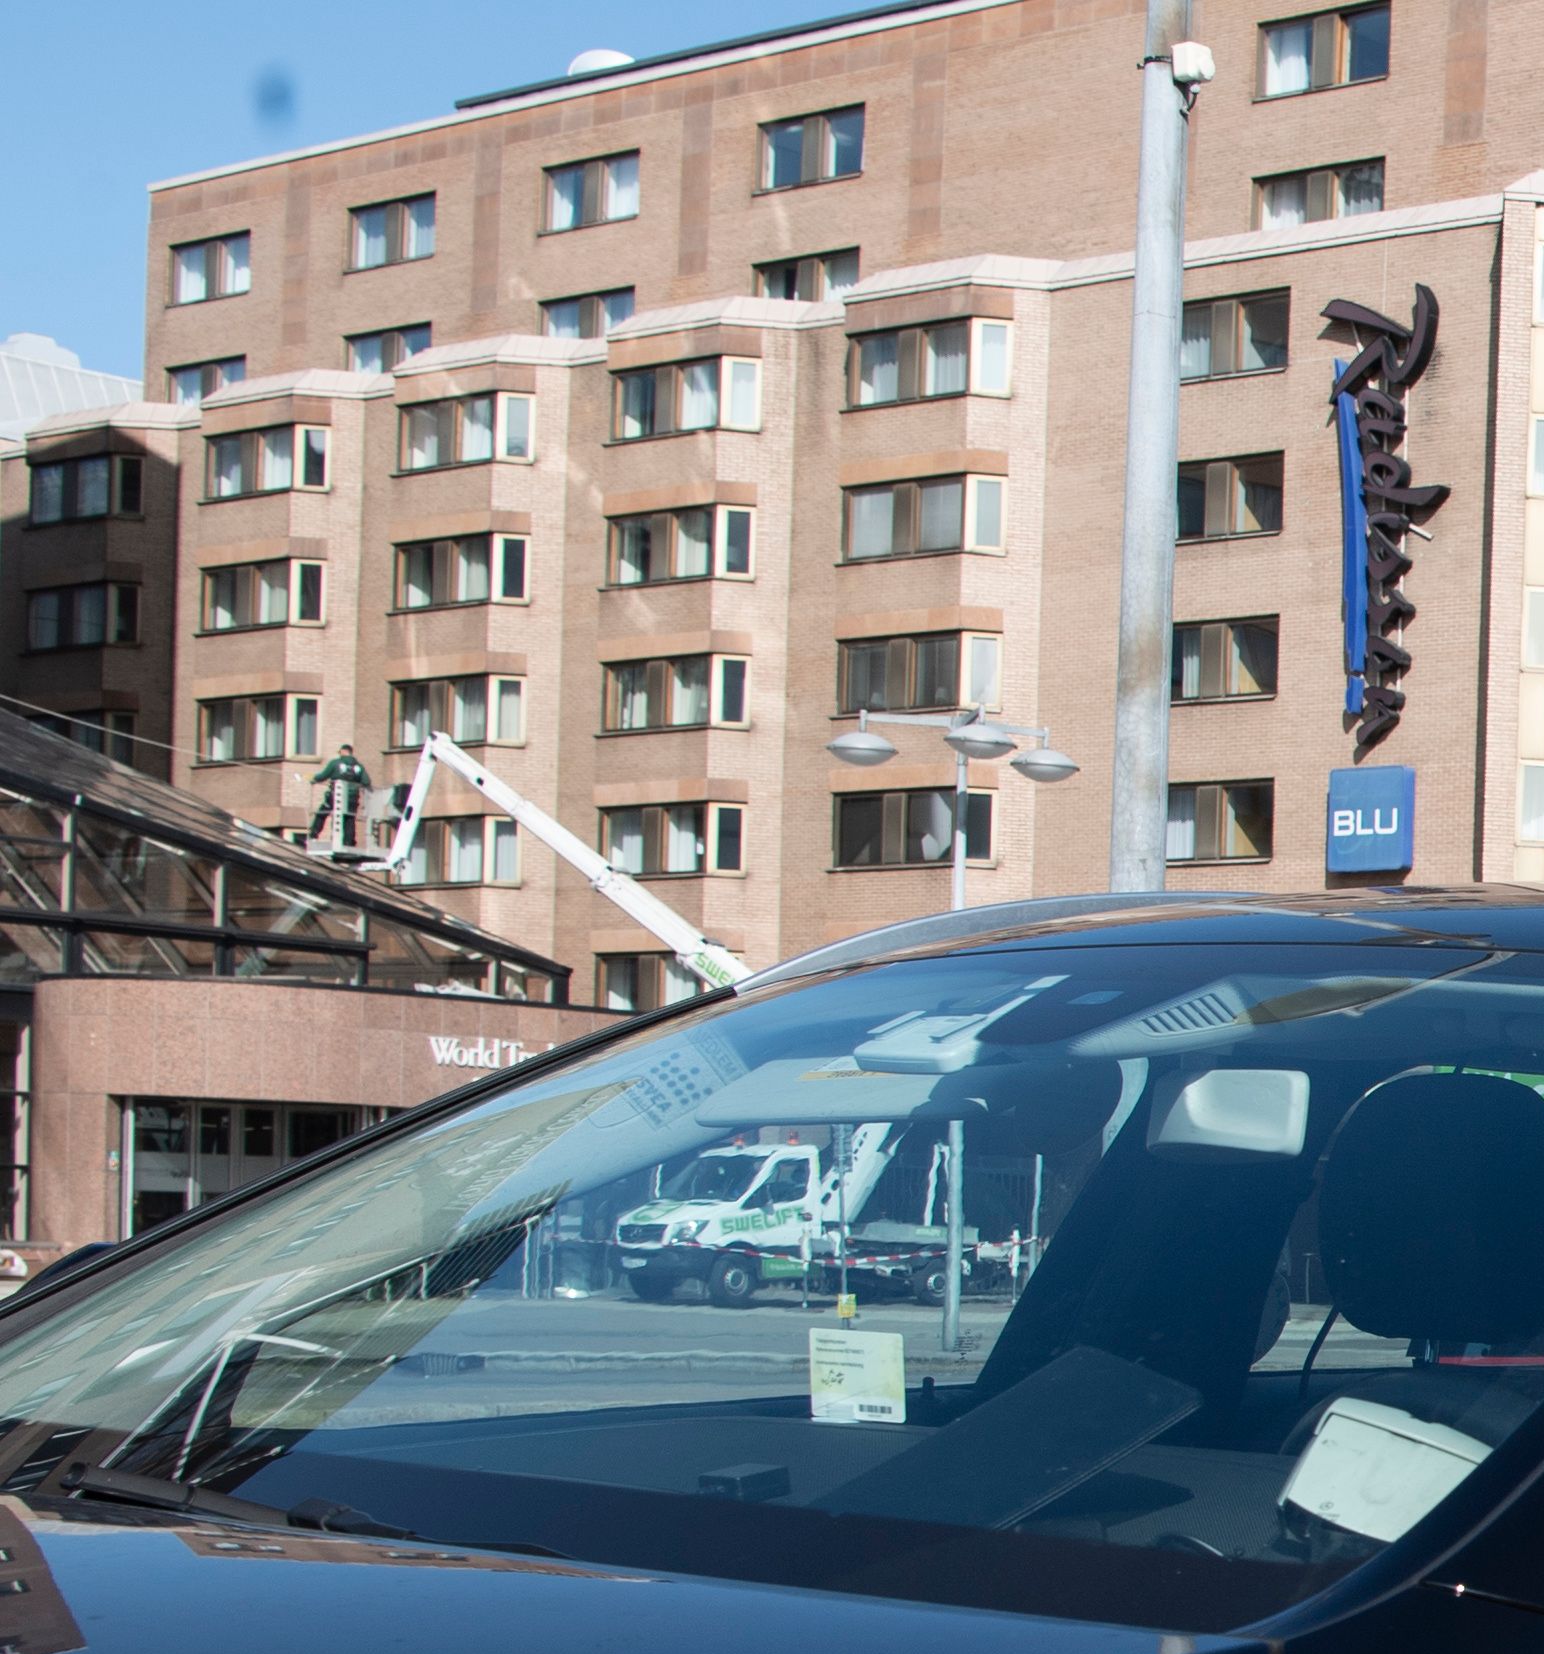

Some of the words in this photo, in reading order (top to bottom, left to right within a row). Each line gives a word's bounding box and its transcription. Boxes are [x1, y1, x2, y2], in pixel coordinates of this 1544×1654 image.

[1320, 283, 1451, 748] Radisson
[1333, 808, 1398, 837] BLU
[695, 953, 737, 987] SWE
[429, 1036, 501, 1069] World
[719, 1206, 805, 1235] SWELIFT
